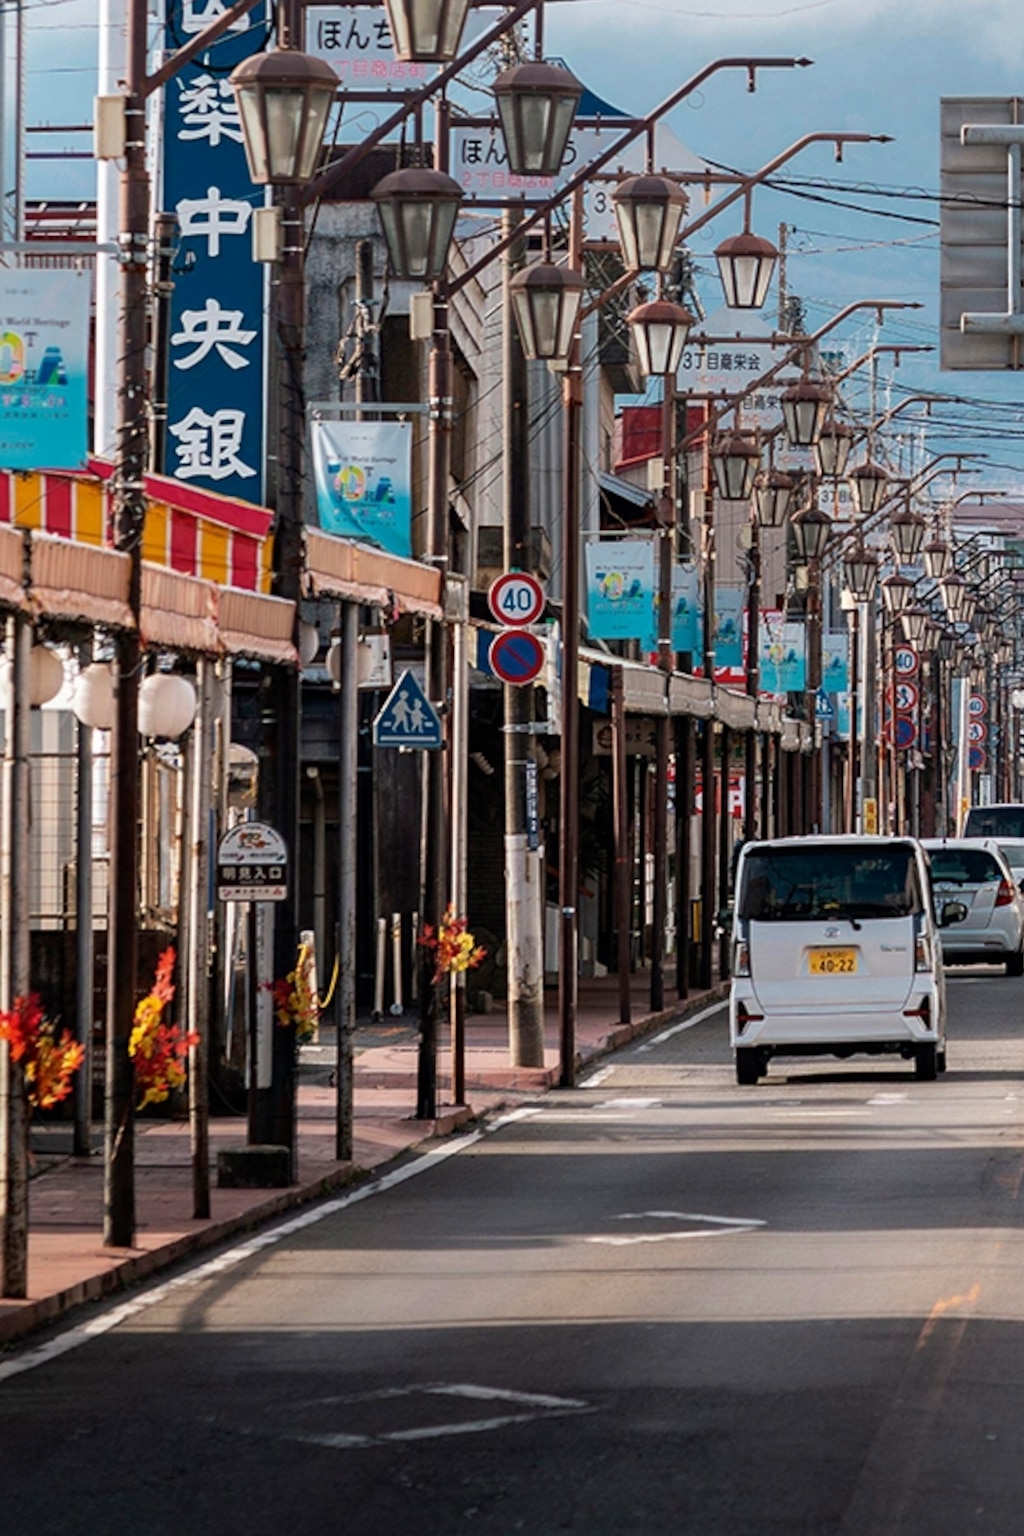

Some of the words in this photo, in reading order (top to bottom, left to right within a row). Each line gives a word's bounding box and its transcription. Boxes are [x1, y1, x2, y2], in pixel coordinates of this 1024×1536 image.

[317, 19, 394, 50] ほんち
[502, 587, 532, 611] 40
[819, 959, 854, 972] 40-22
